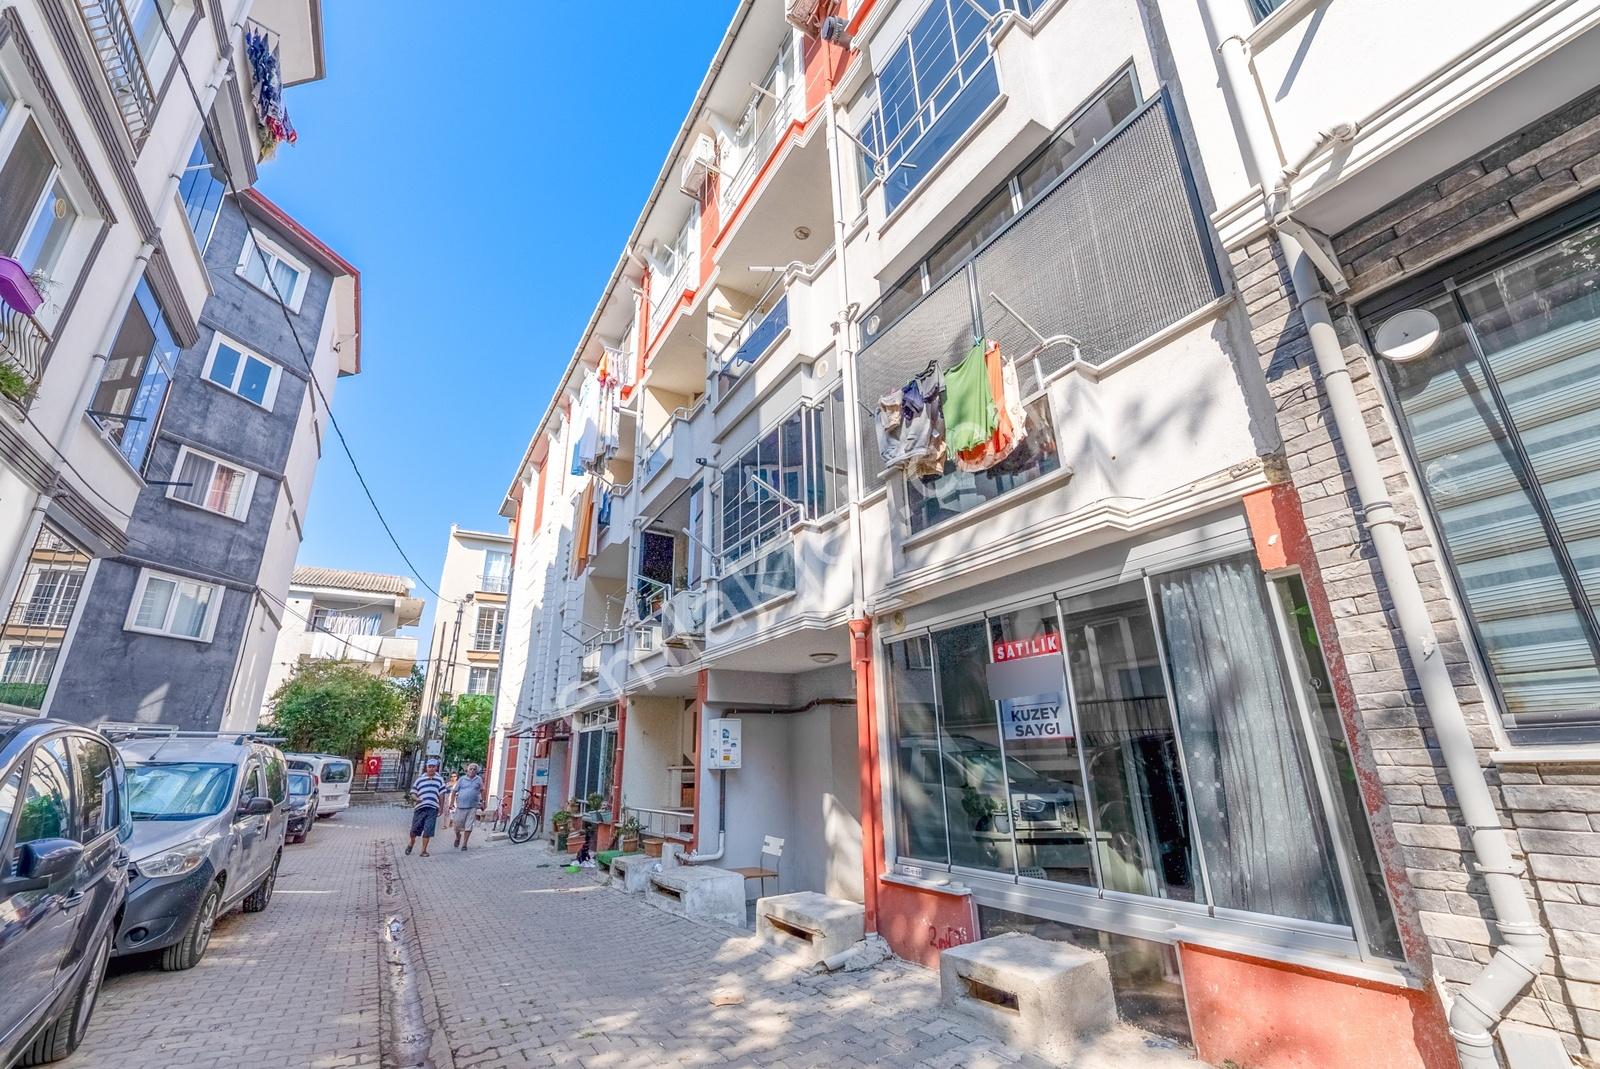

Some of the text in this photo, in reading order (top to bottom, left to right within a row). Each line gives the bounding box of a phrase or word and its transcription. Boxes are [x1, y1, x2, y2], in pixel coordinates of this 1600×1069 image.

[997, 636, 1057, 660] SATILIK
[1011, 706, 1060, 722] KUZEY
[1015, 722, 1061, 737] SAYGI
